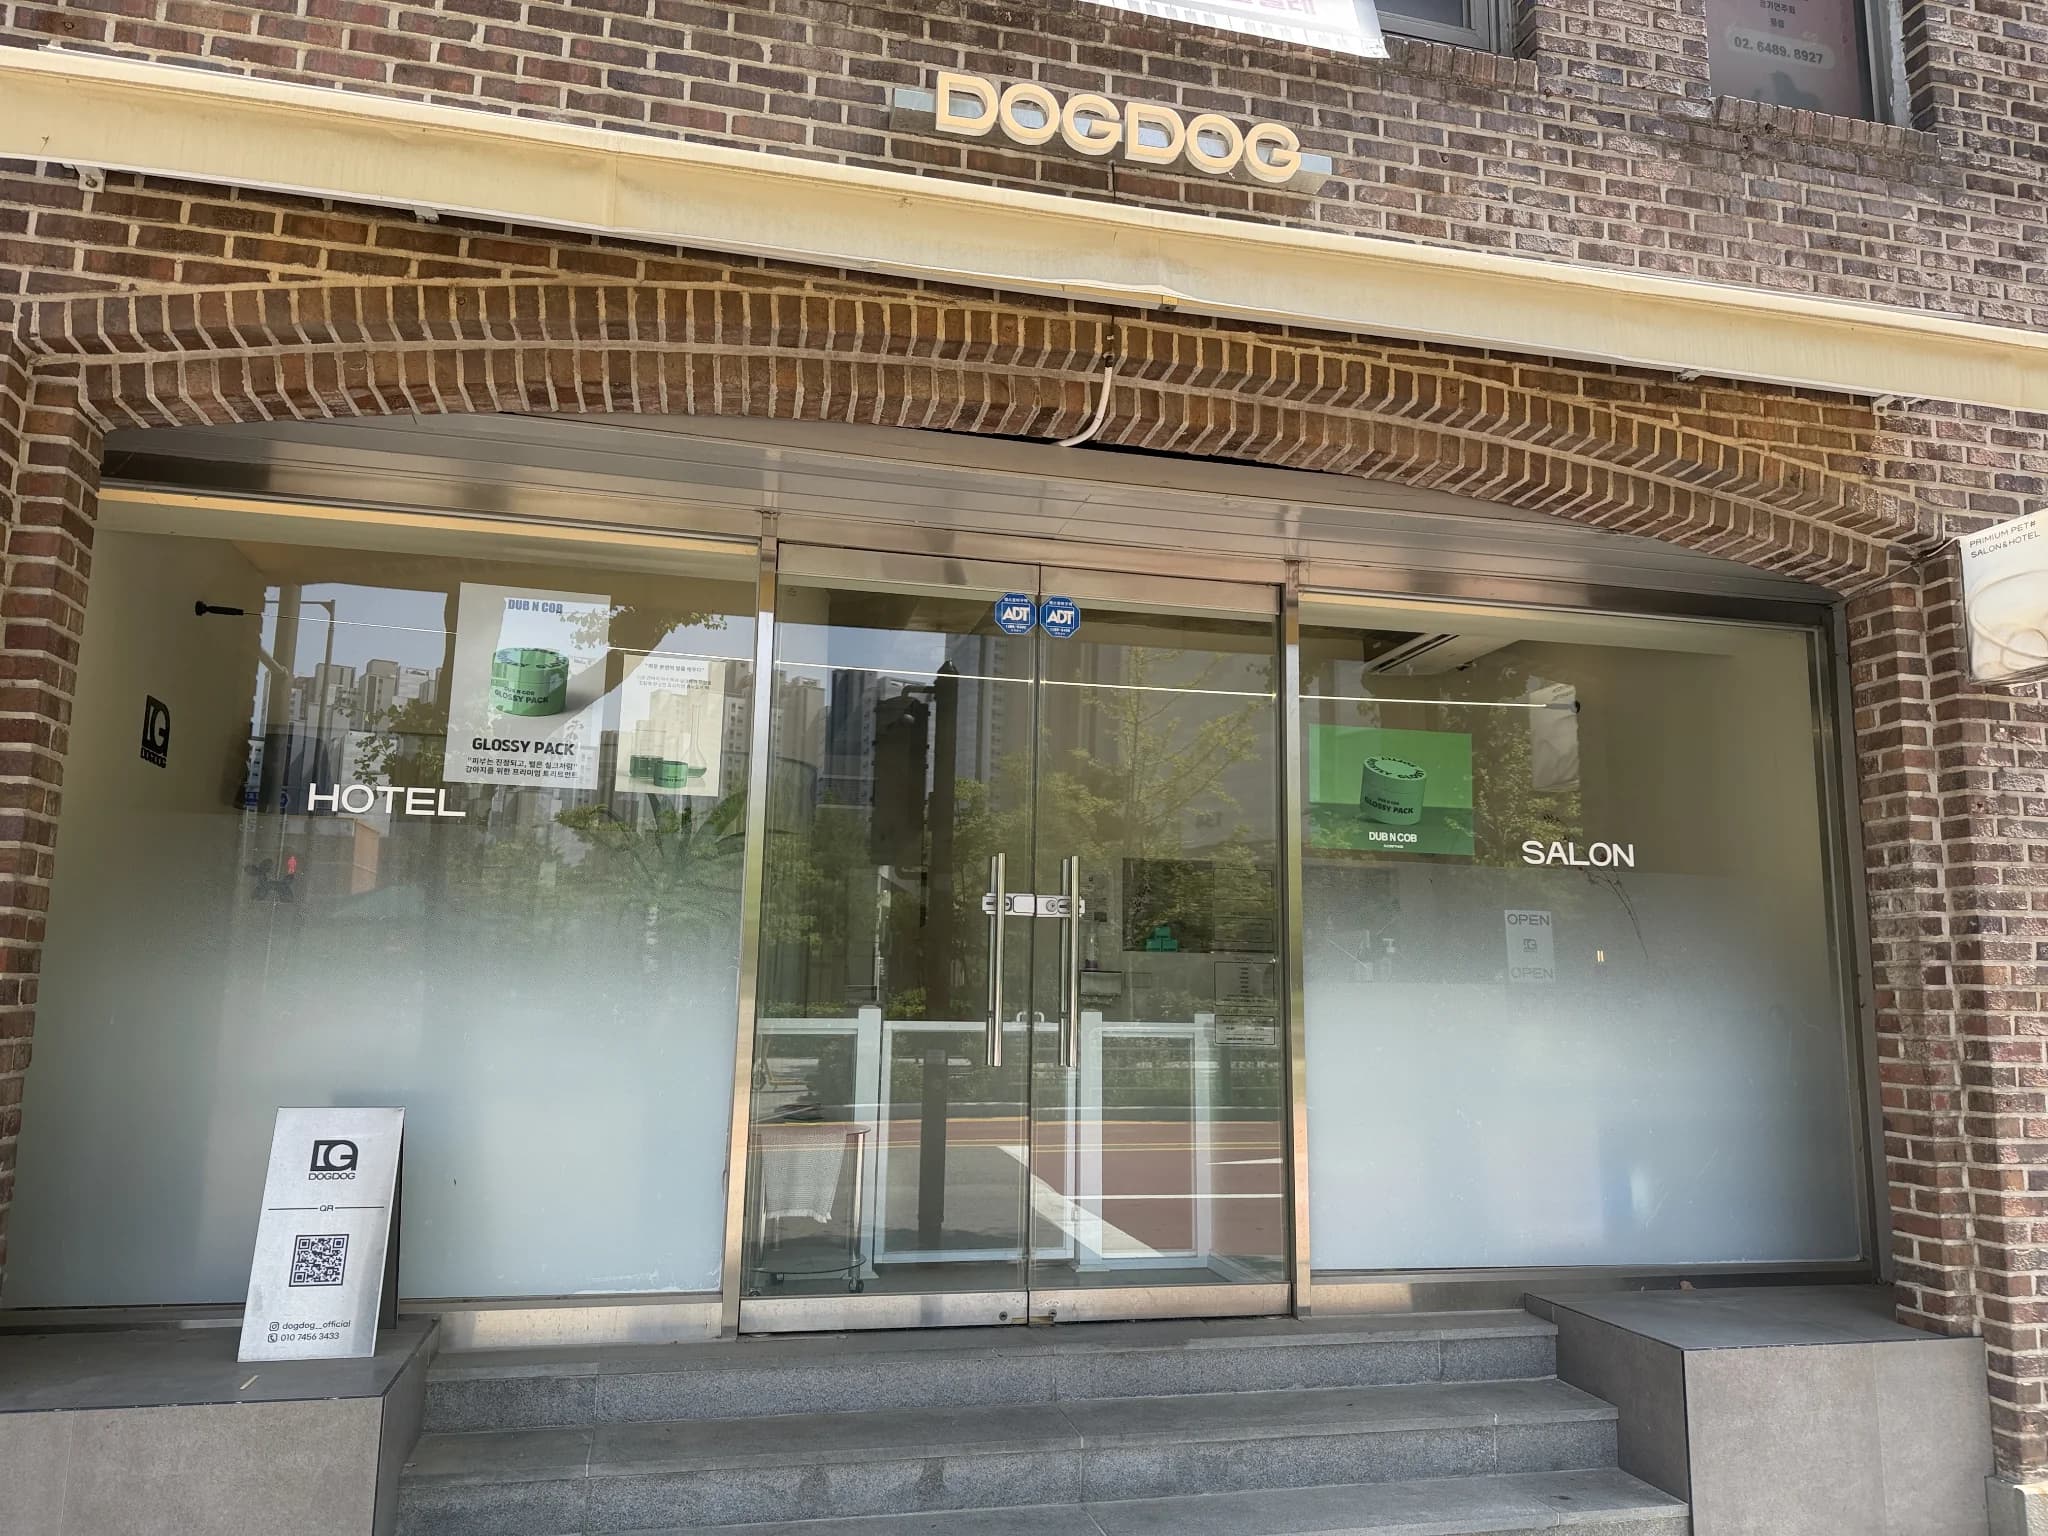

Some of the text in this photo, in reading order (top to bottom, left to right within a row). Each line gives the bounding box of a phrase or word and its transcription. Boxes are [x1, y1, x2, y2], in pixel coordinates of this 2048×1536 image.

[1794, 49, 1823, 64] 8927
[935, 71, 1301, 183] DOGDOG
[1970, 529, 2009, 548] PRIMIUM
[508, 599, 530, 611] DUB
[532, 601, 540, 612] N
[1002, 606, 1030, 622] ADT
[1047, 609, 1074, 625] ADT
[472, 737, 576, 756] GLOSSY PACK
[307, 782, 467, 817] HOTEL
[1368, 831, 1418, 843] DUB N COB
[1521, 840, 1635, 868] SALON
[1507, 913, 1550, 926] OPEN
[1510, 967, 1554, 979] OPEN
[308, 1172, 356, 1181] DOGDOG
[319, 1204, 334, 1212] QR
[280, 1331, 340, 1342] 010 7456 3433
